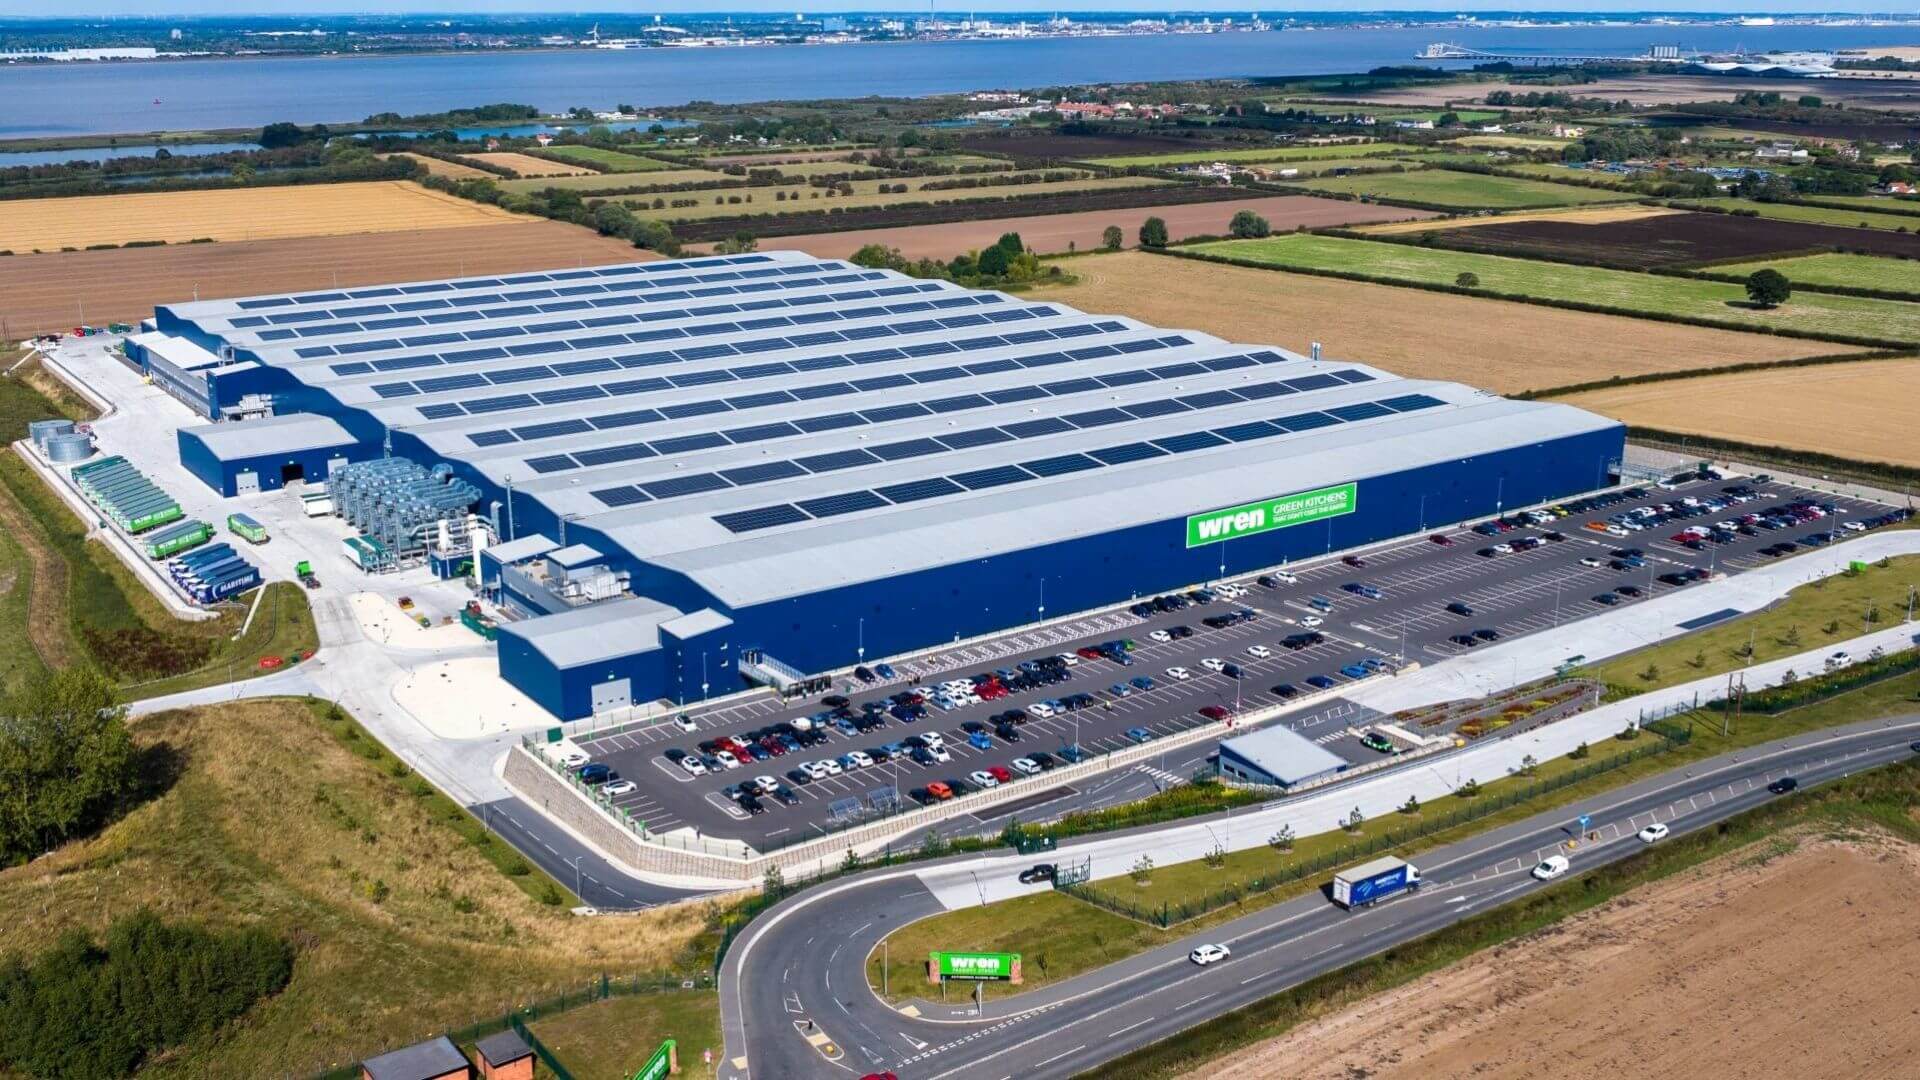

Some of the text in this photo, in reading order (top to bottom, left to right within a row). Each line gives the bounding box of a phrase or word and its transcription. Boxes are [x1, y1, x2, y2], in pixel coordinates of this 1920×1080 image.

[1273, 490, 1348, 514] GREEN KITCHENS
[1198, 508, 1265, 540] wren
[950, 957, 1000, 969] wren
